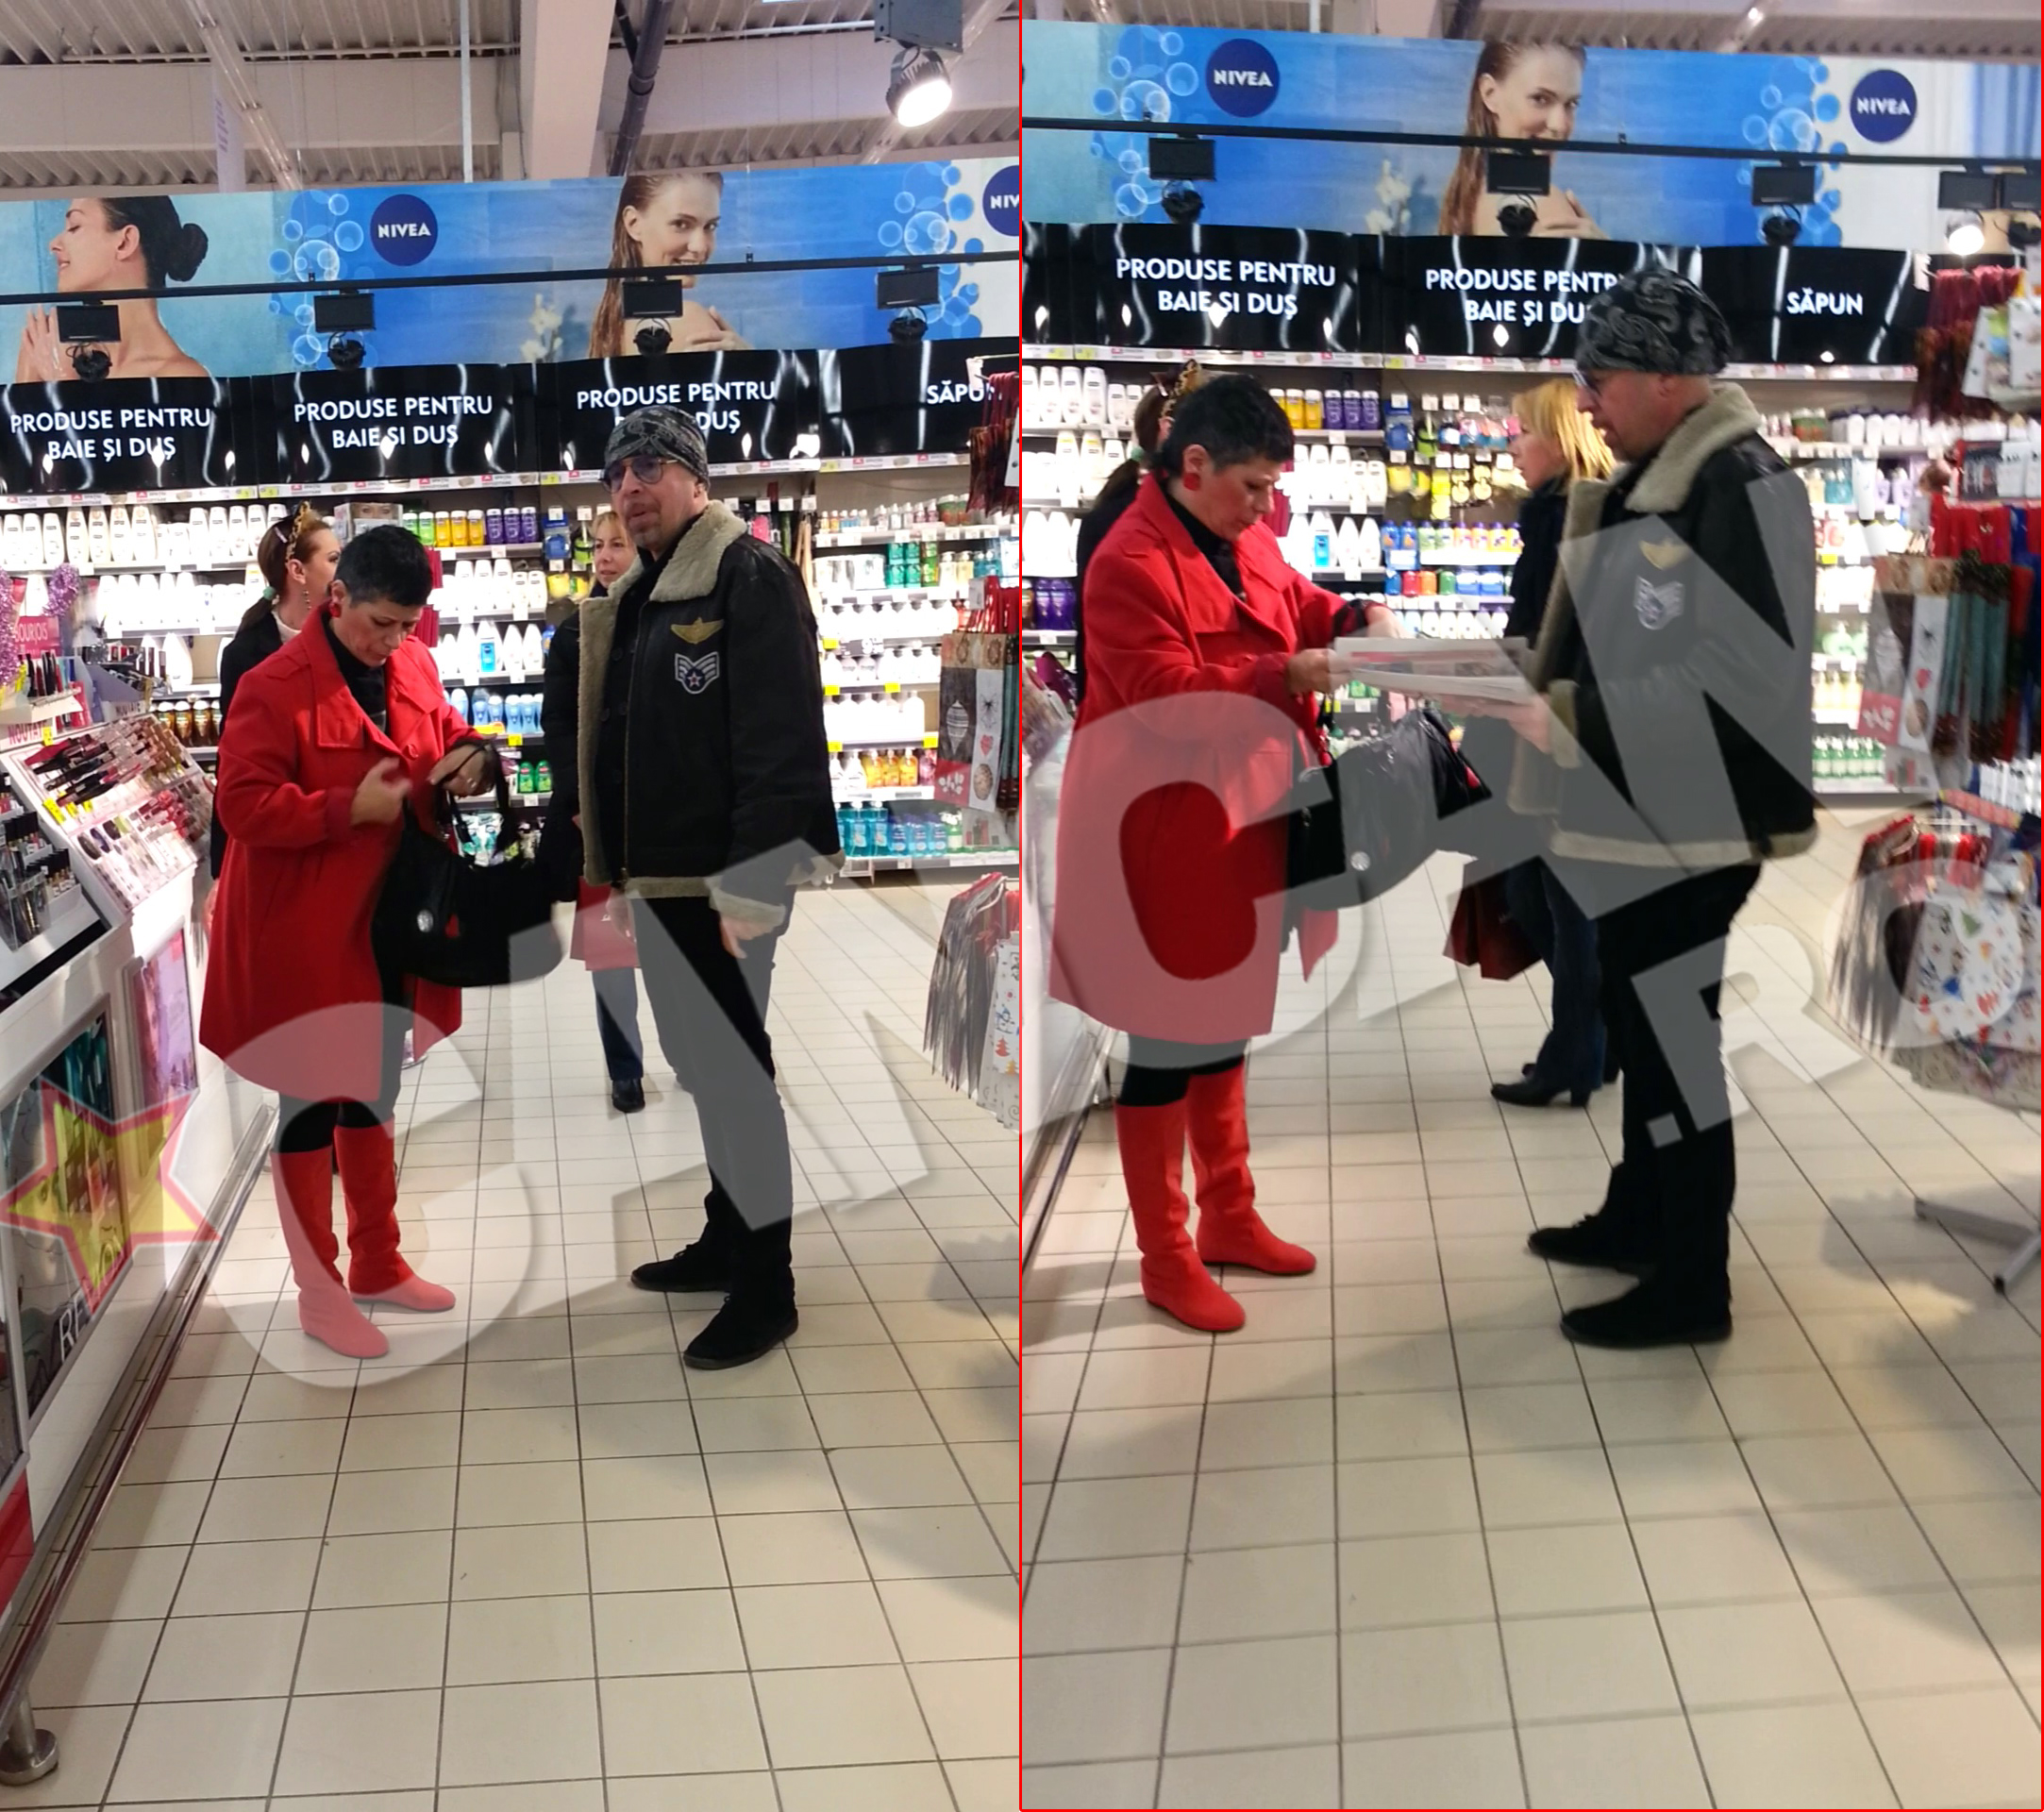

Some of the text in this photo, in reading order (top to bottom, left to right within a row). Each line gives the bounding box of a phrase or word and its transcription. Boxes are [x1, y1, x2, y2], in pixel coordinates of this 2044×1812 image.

[1214, 69, 1273, 88] NIVEA
[1857, 97, 1911, 116] NIVEA
[378, 223, 431, 239] NIVEA
[1116, 258, 1335, 286] PRODUSE PENTRU
[1427, 269, 1621, 292] PRODUSE PENTR
[1159, 290, 1211, 311] BAIE
[1248, 293, 1298, 320] DUȘ
[1466, 300, 1591, 327] BAIE ȘI DU
[1787, 288, 1864, 315] SĂPUN
[577, 381, 776, 409] PRODUSE PENTRU
[10, 408, 211, 433] PRODUSE PENTRU
[294, 395, 493, 423] PRODUSE PENTRU
[695, 411, 741, 434] DUȘ
[332, 428, 379, 448] BAIE
[413, 425, 459, 448] DUȘ
[48, 437, 176, 462] BAIE ȘI DUȘ
